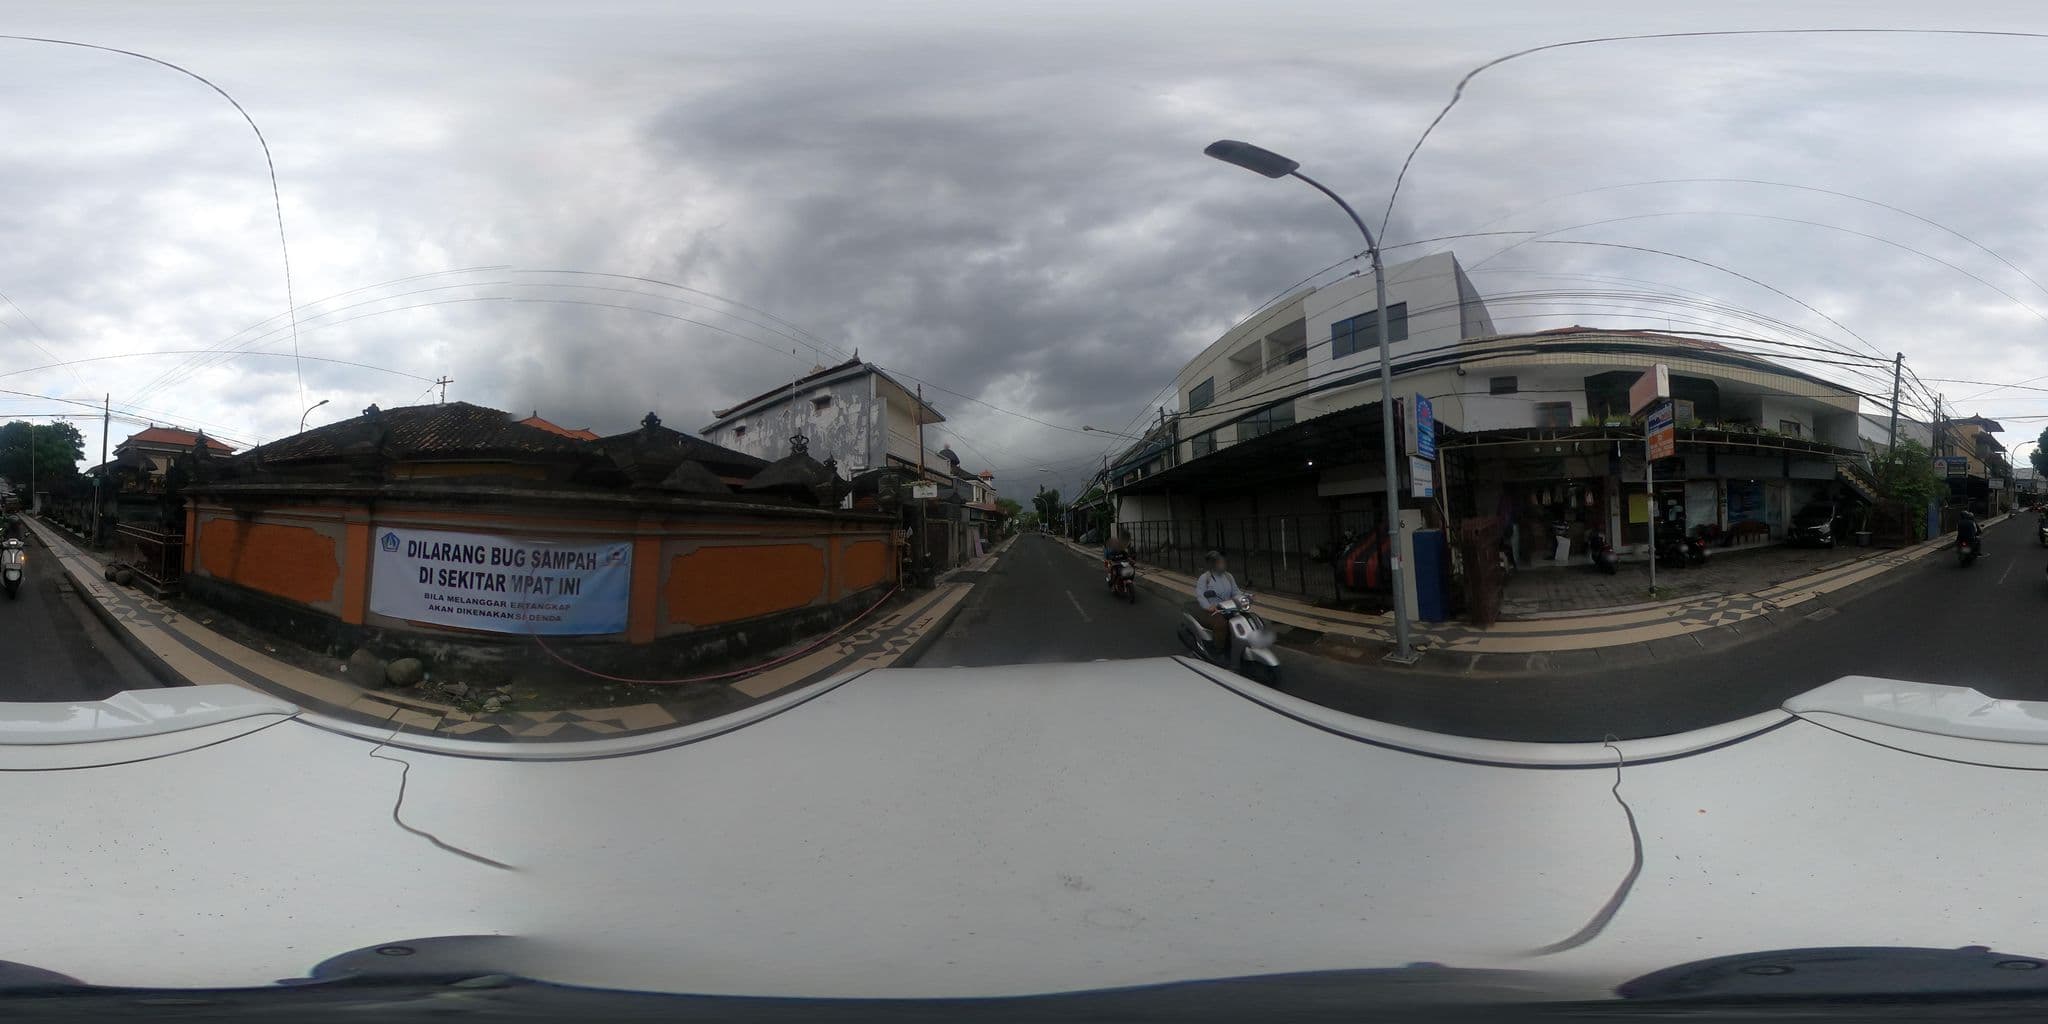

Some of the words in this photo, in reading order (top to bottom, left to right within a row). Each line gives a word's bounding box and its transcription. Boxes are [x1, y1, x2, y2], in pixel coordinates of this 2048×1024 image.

[408, 540, 486, 565] DILARANG
[491, 547, 526, 568] BUG
[531, 549, 597, 571] SAMPAH
[419, 566, 434, 585] DI
[438, 568, 506, 593] SEKITAR
[559, 577, 581, 596] INI
[424, 592, 445, 602] BILA
[447, 595, 507, 608] MELANGGAR
[428, 604, 454, 614] AKAN
